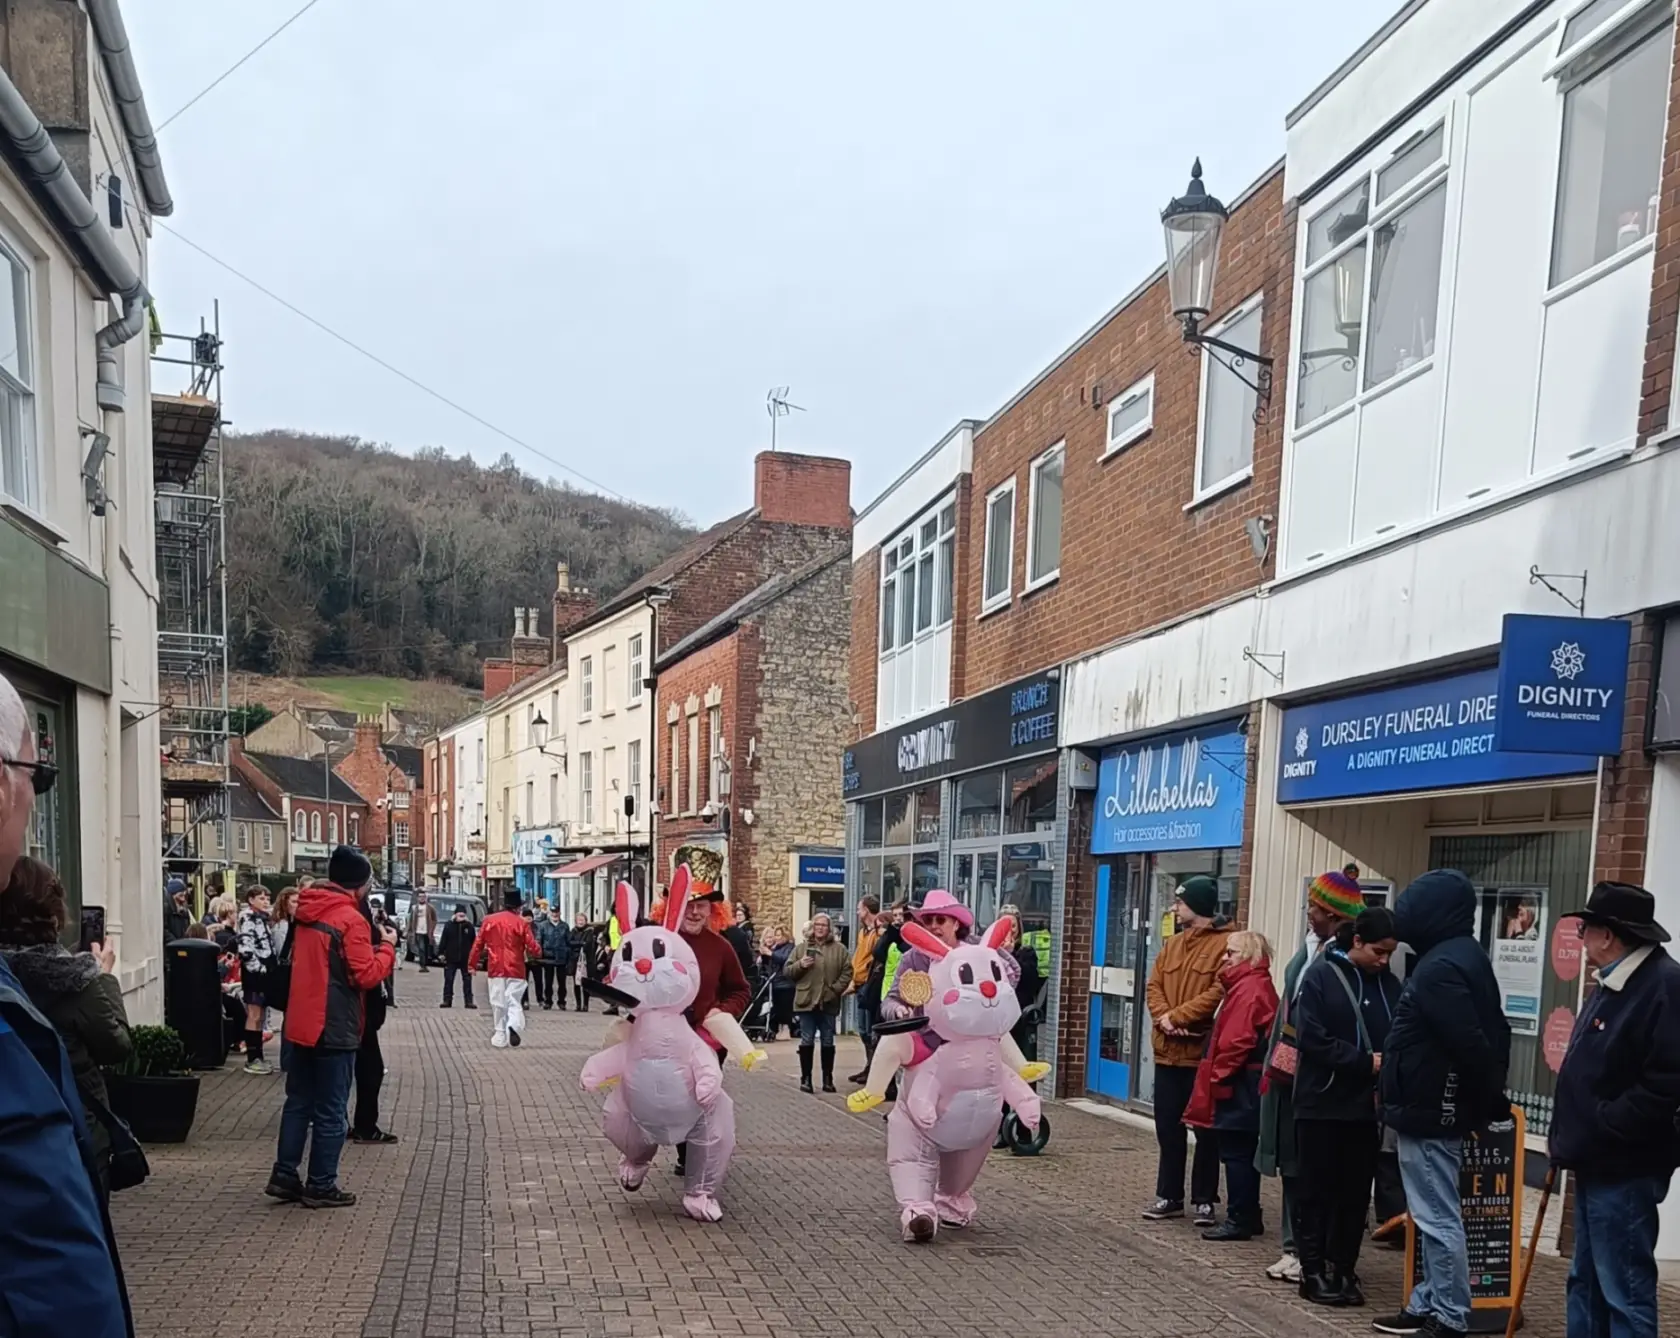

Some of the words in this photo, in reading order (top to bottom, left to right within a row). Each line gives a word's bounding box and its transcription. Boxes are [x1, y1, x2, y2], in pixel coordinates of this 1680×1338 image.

[1011, 681, 1050, 716] BRUNCH
[1518, 684, 1613, 708] DIGNITY
[1322, 715, 1383, 748] DURSLEY
[1385, 703, 1454, 737] FUNERAL
[1458, 694, 1498, 725] DIRE
[1527, 710, 1559, 719] FUNERAL
[1561, 712, 1600, 721] DIRECTORS
[1018, 711, 1056, 745] COFFEE
[1347, 754, 1355, 771] A
[1357, 748, 1398, 769] DIGNITY
[1399, 741, 1449, 764] FUNERAL
[1451, 734, 1495, 757] DIRECT
[1105, 736, 1219, 818] Lillabellas
[1284, 760, 1317, 778] DIGNITY
[1127, 826, 1167, 841] accessories
[806, 866, 845, 874] www.benn
[1463, 1147, 1500, 1157] SSIC
[1466, 1155, 1511, 1165] RSHOP
[1473, 1173, 1508, 1196] EN
[1475, 1205, 1509, 1215] TIMES
